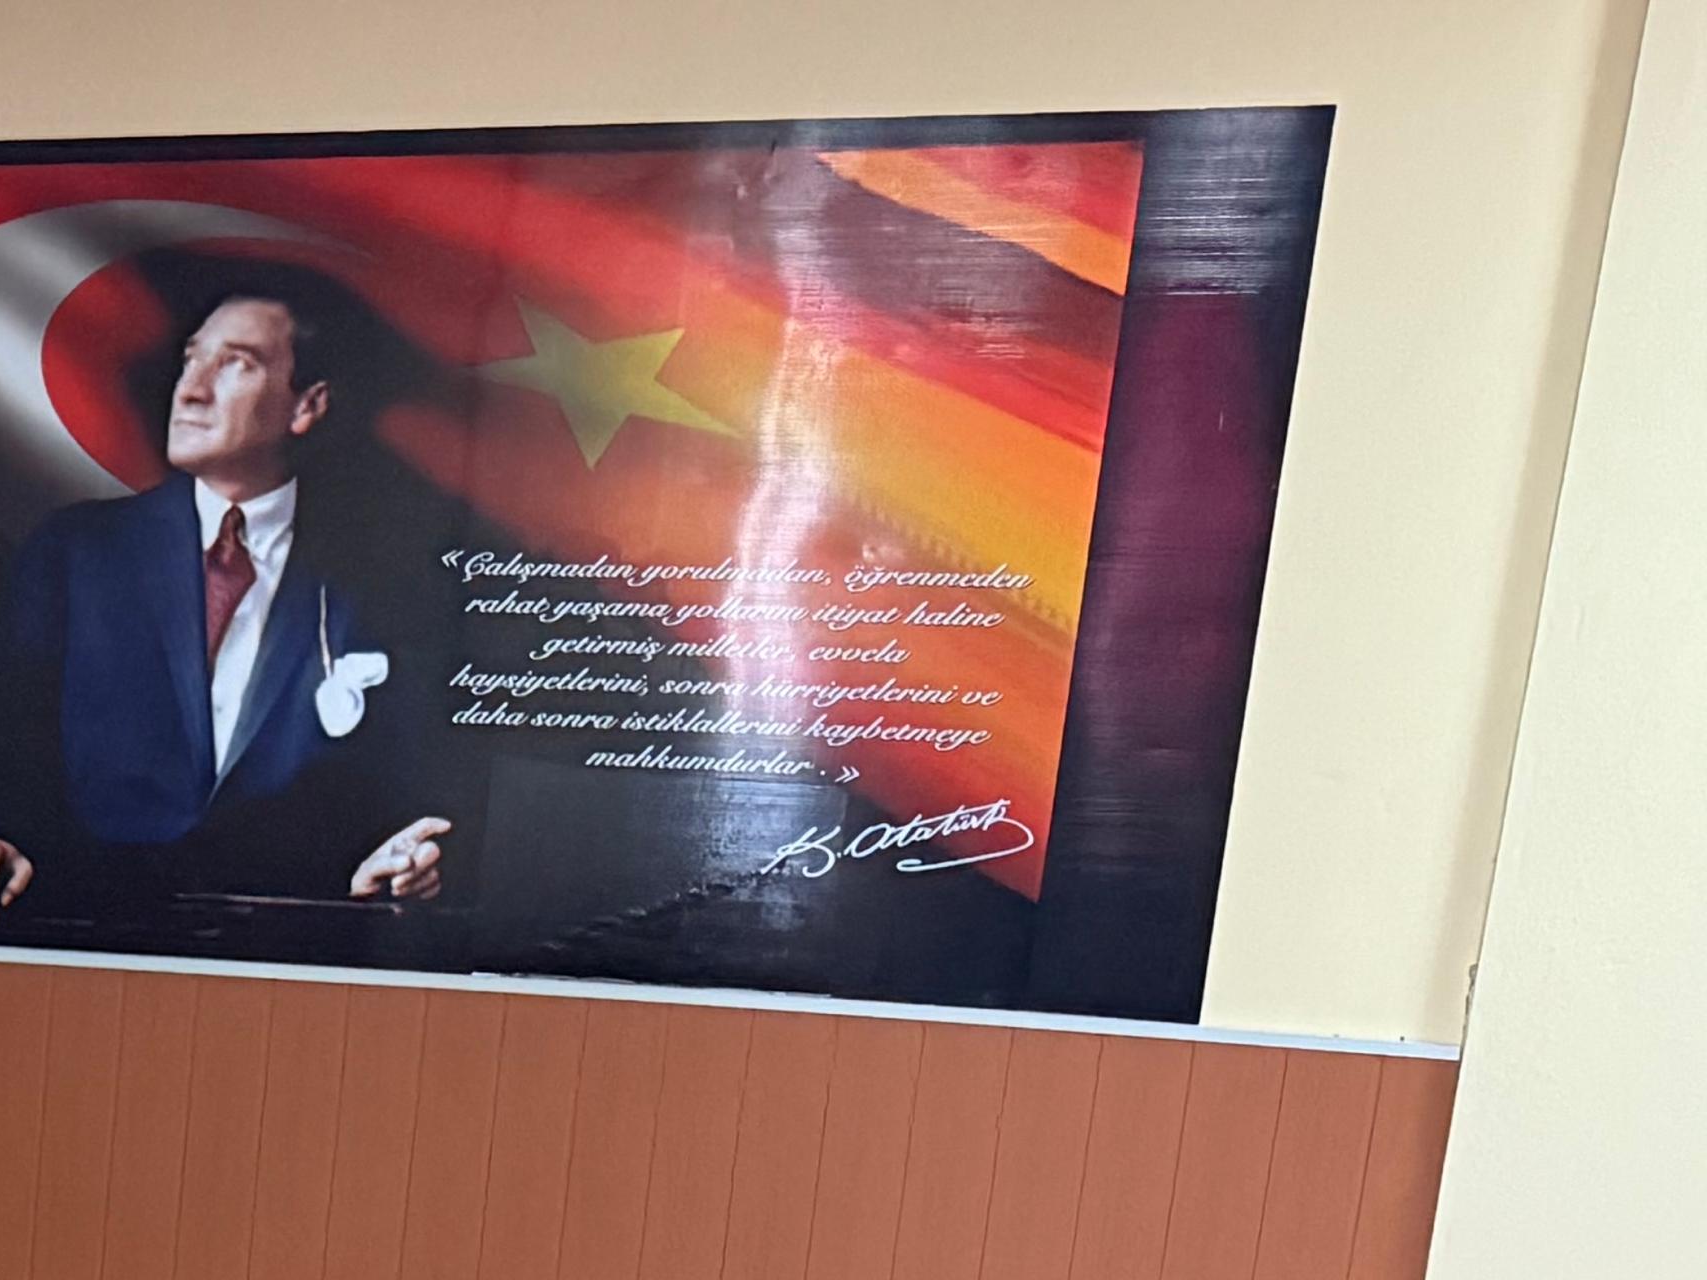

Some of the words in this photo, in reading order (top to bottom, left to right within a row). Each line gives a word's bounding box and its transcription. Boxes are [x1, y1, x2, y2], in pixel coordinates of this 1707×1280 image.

[844, 563, 1035, 592] öğrenmeden
[464, 590, 549, 614] rahat
[539, 599, 671, 623] yaşama
[904, 601, 1004, 628] haline
[529, 635, 663, 662] getirmiş
[449, 664, 649, 697] haysiyetlerini,
[659, 676, 747, 697] sonra
[750, 673, 958, 708] hürriyetlerini
[961, 690, 1003, 706] ve
[451, 701, 529, 725] daha
[530, 711, 619, 730] sonra
[621, 708, 801, 736] istiklallerini
[803, 714, 992, 752] kaybetmeye
